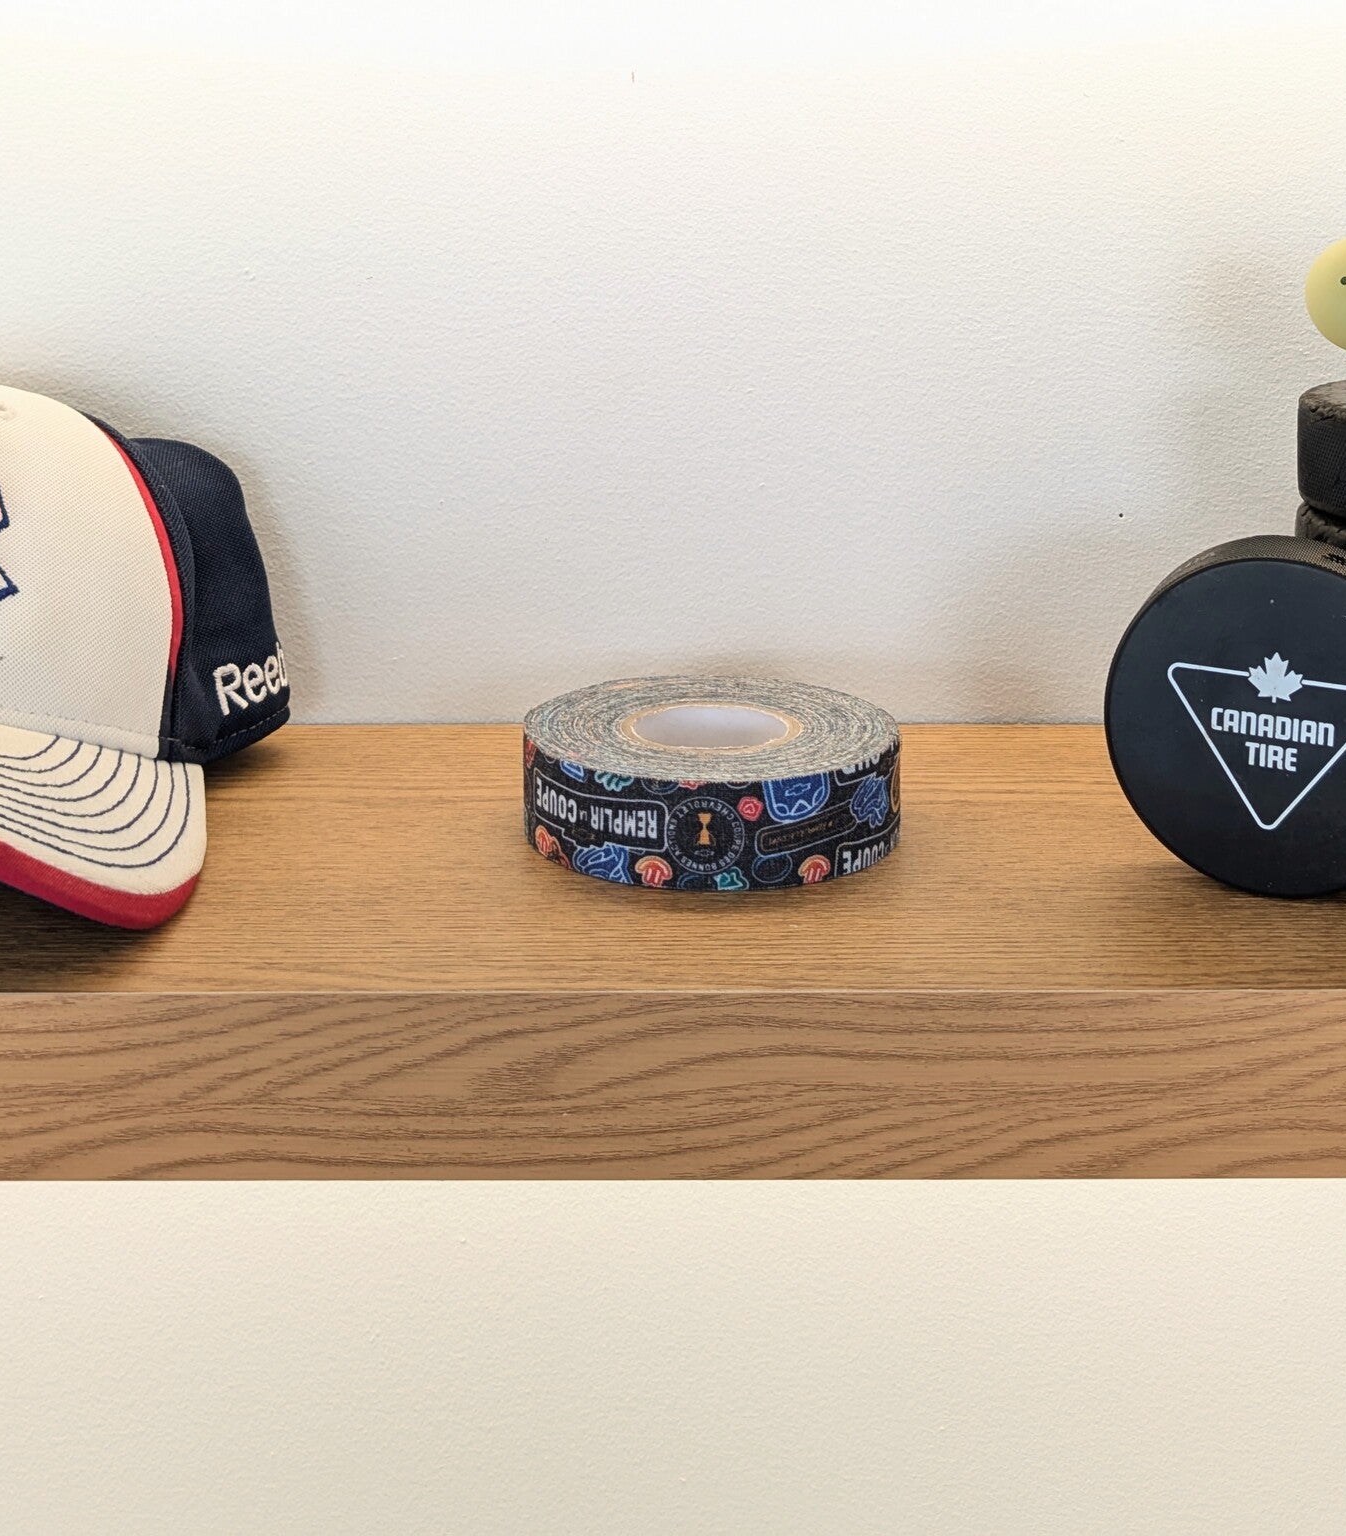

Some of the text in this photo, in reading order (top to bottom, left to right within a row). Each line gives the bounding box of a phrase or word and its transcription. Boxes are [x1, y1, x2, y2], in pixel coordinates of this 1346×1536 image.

[1210, 707, 1335, 748] CANADIAN
[1244, 741, 1298, 772] TIRE
[536, 777, 577, 823] COUPE
[676, 800, 735, 820] CHEVROLET
[590, 805, 657, 839] REMPLIR
[667, 818, 683, 856] ACTIONS
[680, 855, 718, 871] BONNES
[719, 851, 735, 867] DES
